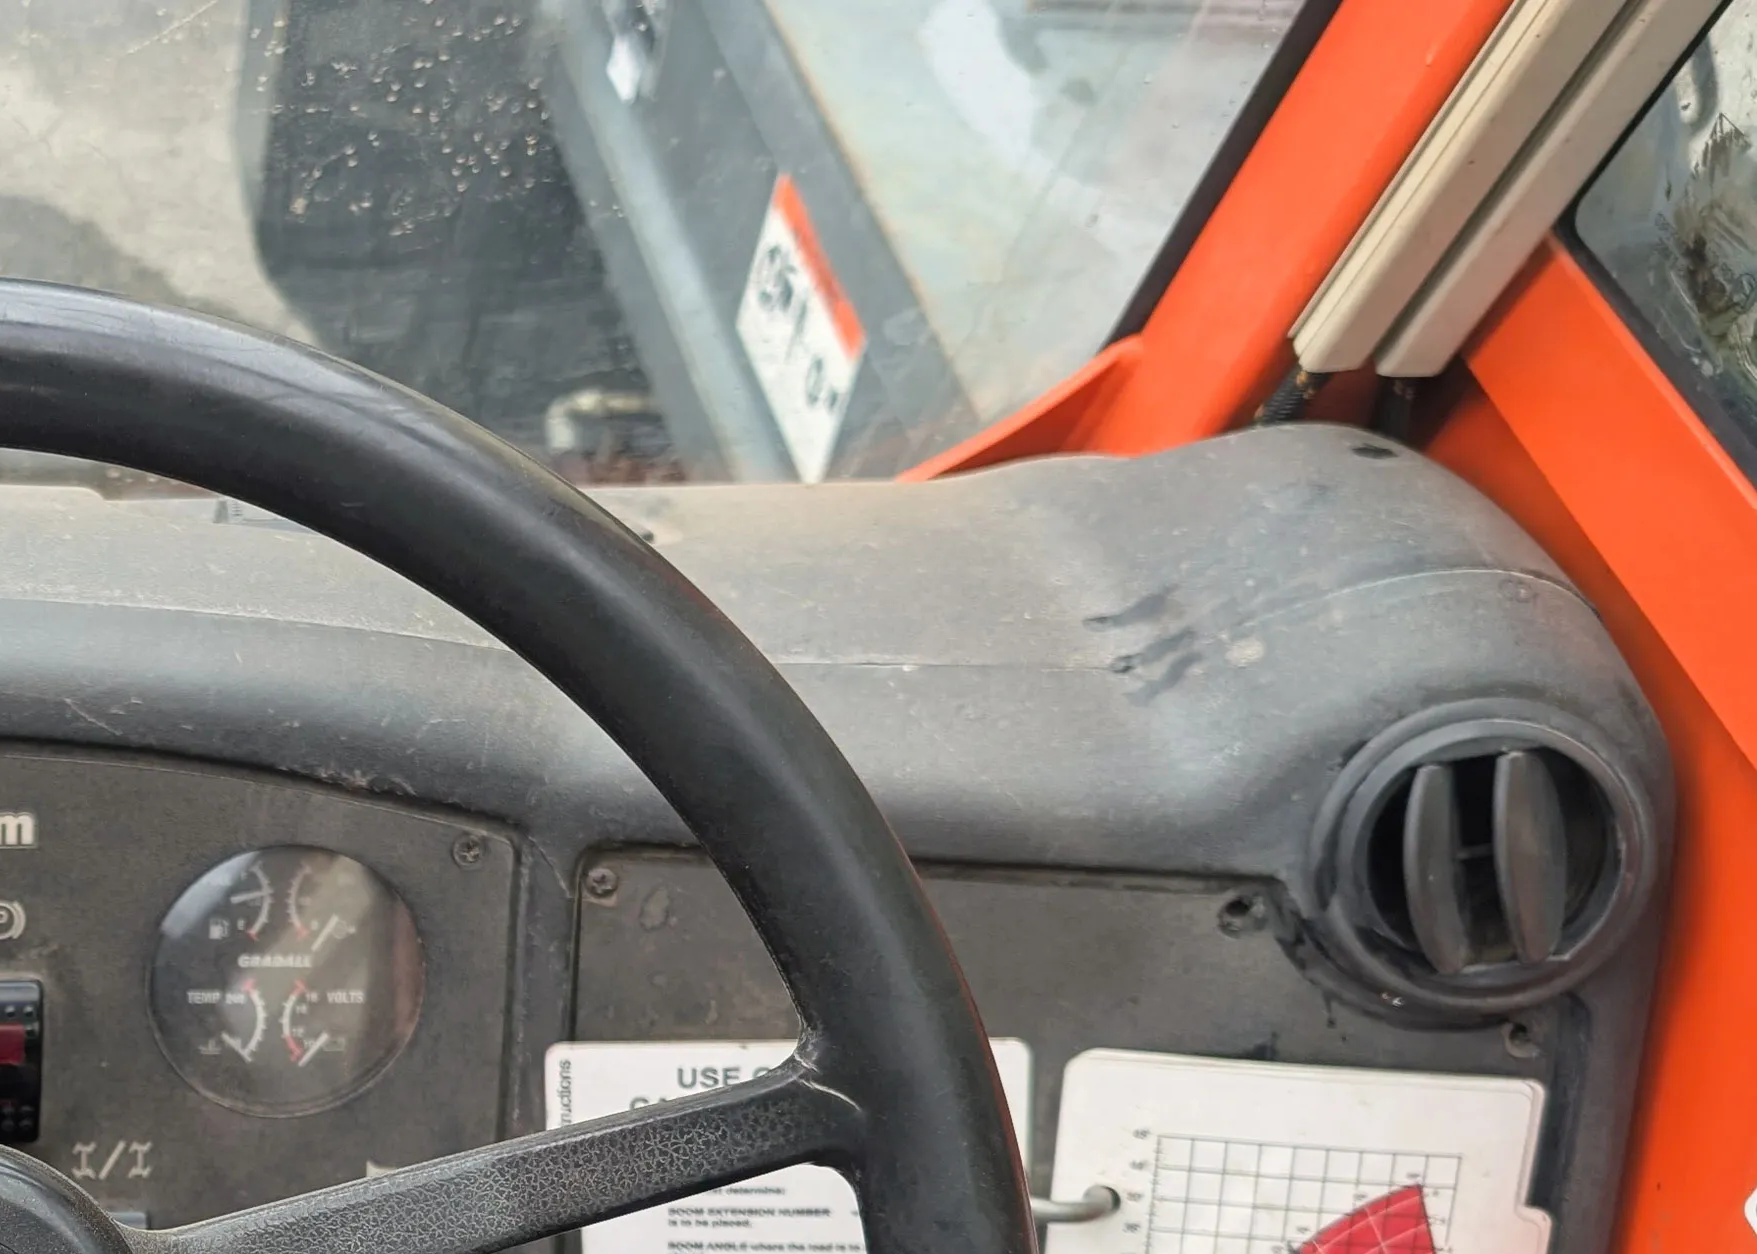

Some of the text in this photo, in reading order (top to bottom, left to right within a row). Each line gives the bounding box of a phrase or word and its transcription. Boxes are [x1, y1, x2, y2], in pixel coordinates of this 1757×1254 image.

[187, 991, 221, 1005] TEMP
[326, 990, 365, 1005] VOLTS
[676, 1066, 741, 1090] USE
